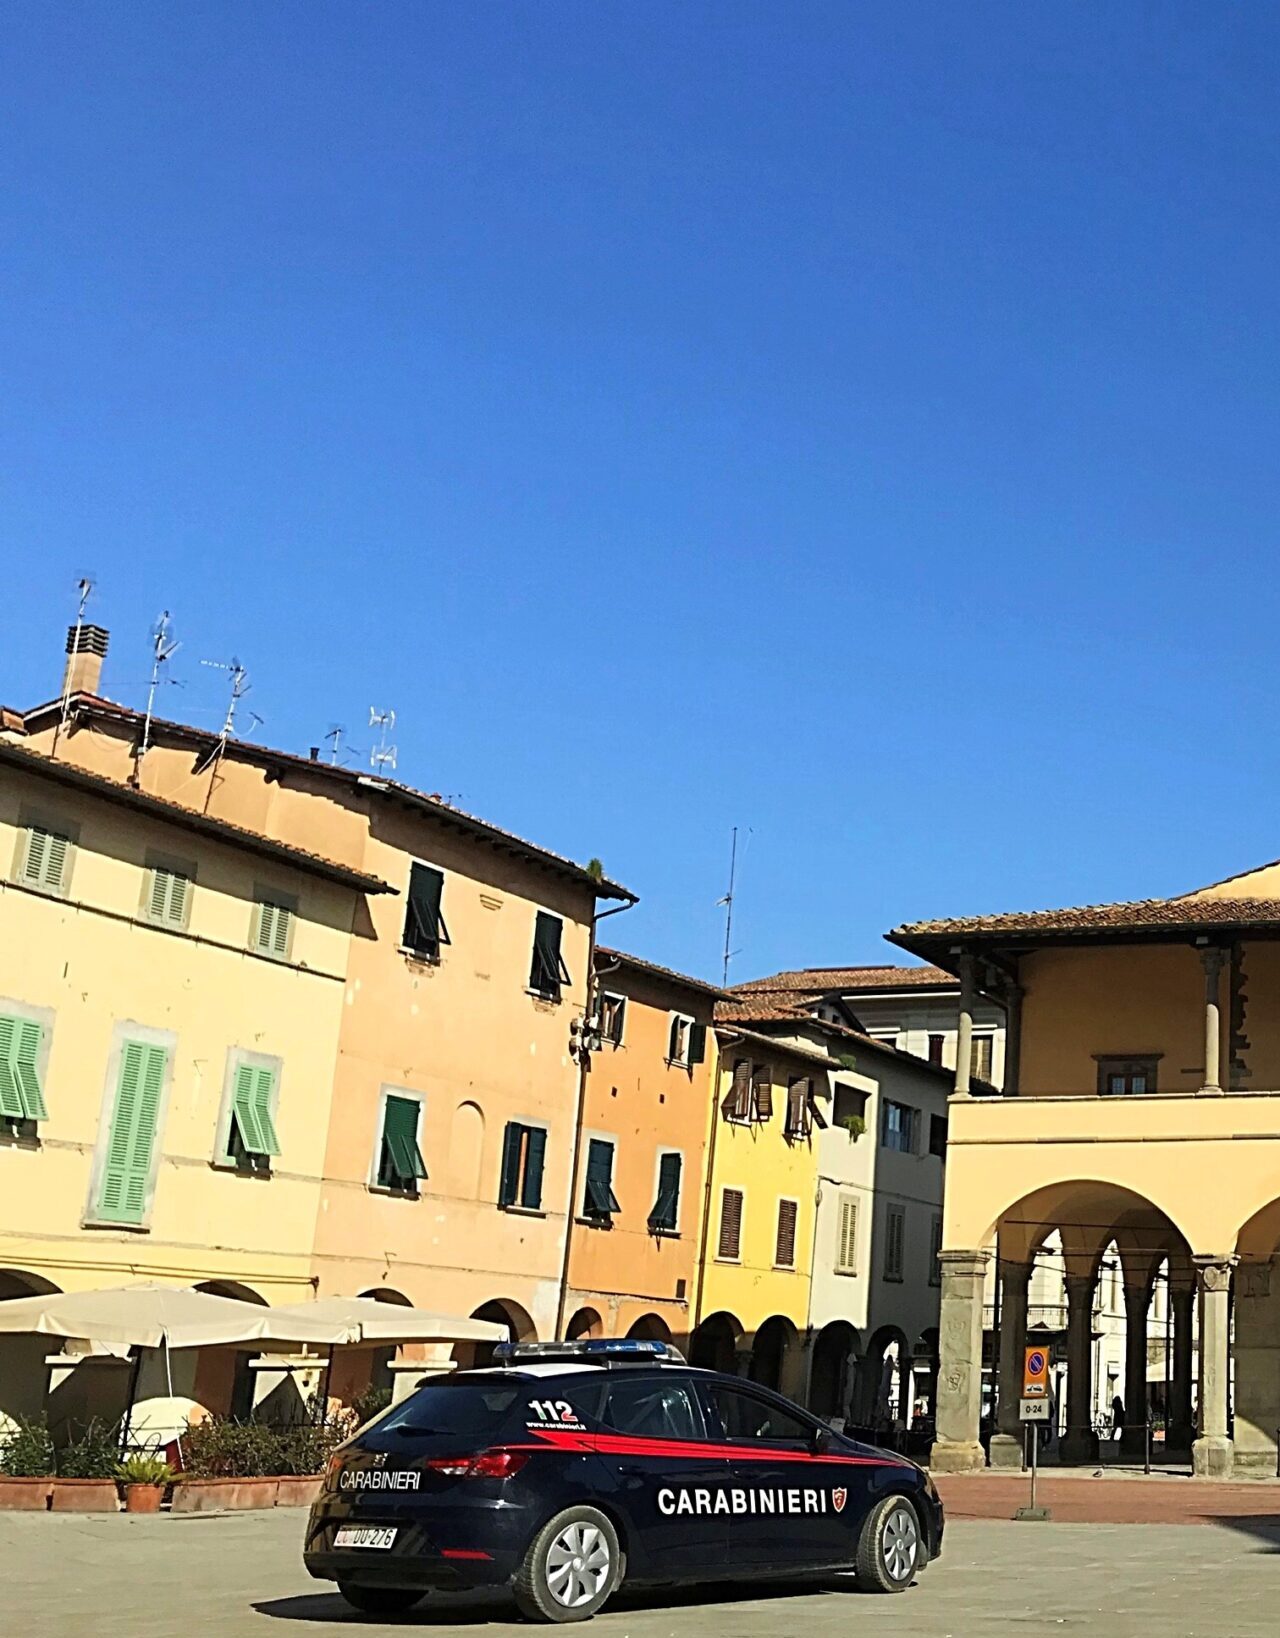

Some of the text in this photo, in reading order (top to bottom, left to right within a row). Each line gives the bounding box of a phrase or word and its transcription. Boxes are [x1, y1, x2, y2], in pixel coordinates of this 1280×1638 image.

[528, 1399, 579, 1422] 112
[1025, 1405, 1042, 1414] 0-24
[525, 1421, 587, 1431] www.carabinieri.it
[340, 1470, 421, 1490] CARABINIERI
[658, 1488, 827, 1515] CARABINIERI
